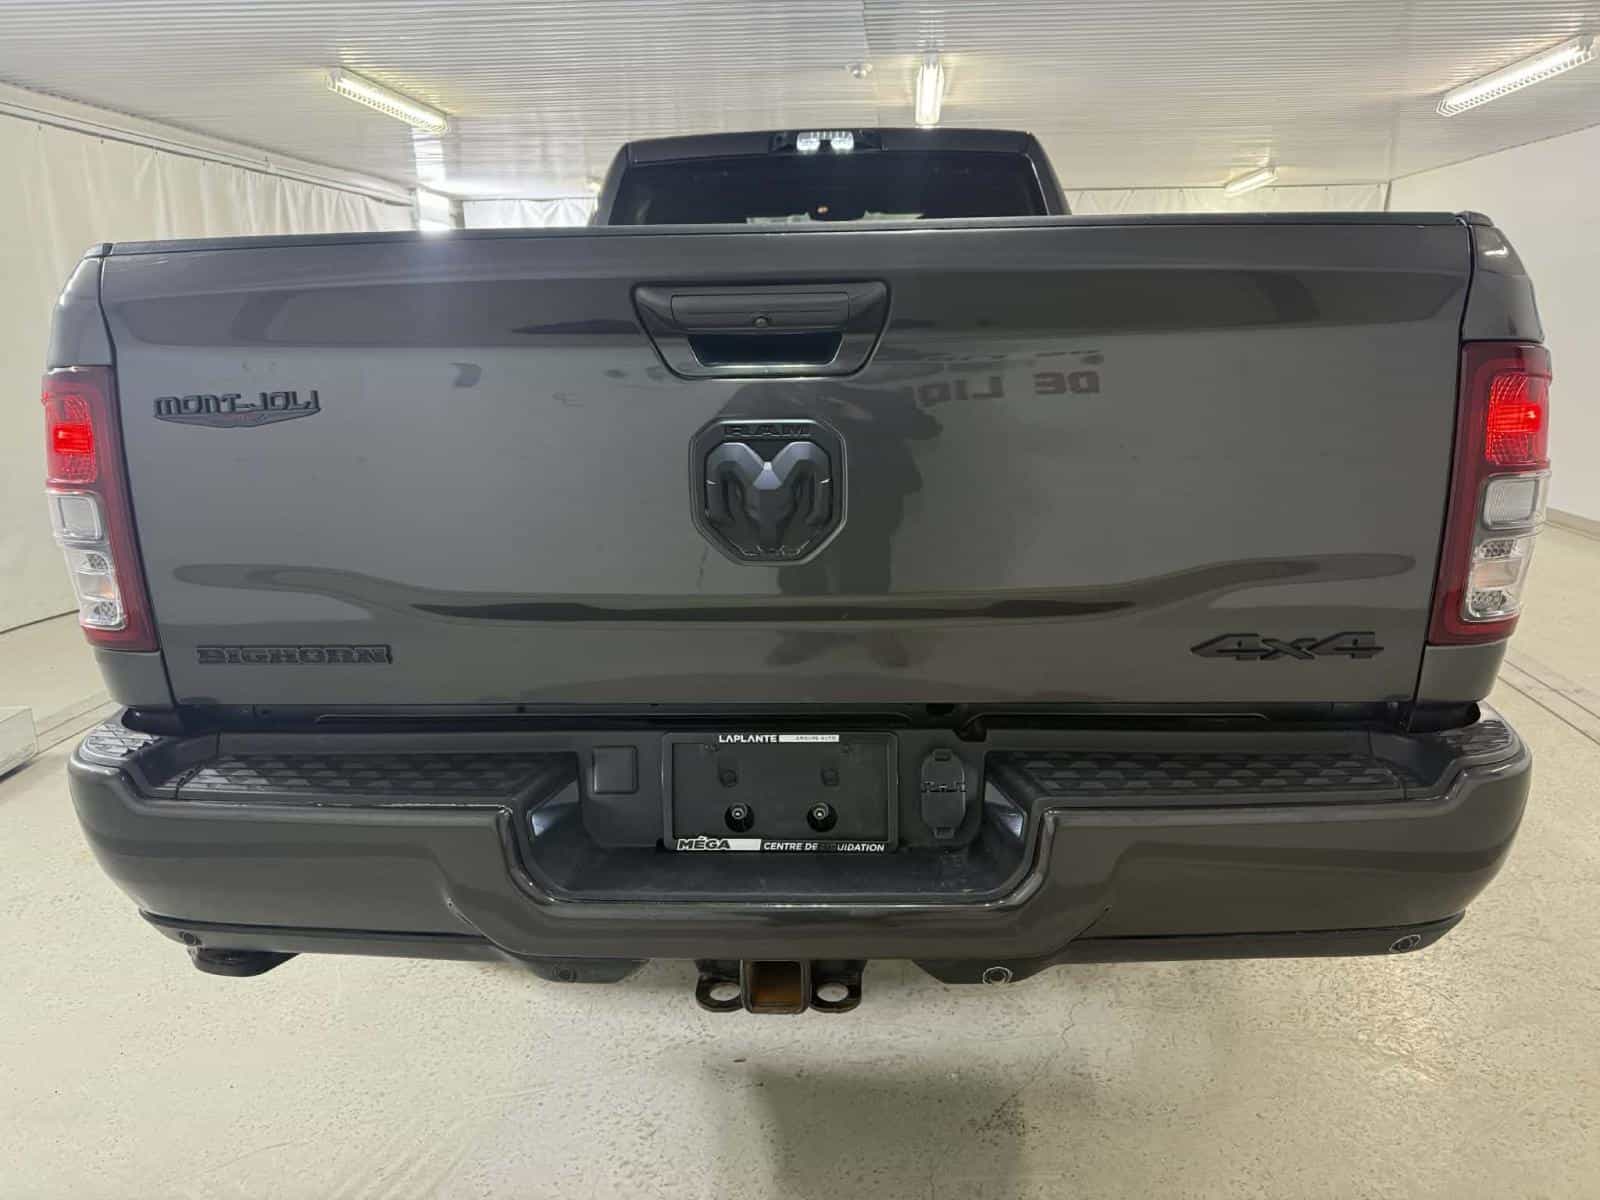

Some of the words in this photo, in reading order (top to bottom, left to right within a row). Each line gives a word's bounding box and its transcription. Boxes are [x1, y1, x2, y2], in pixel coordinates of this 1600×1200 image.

[153, 390, 320, 416] MONT-JOLI
[724, 424, 812, 437] RAM
[719, 734, 777, 743] LAPLANTE
[677, 836, 731, 850] MÉGA
[763, 842, 802, 851] CENTRE
[804, 842, 818, 851] DE
